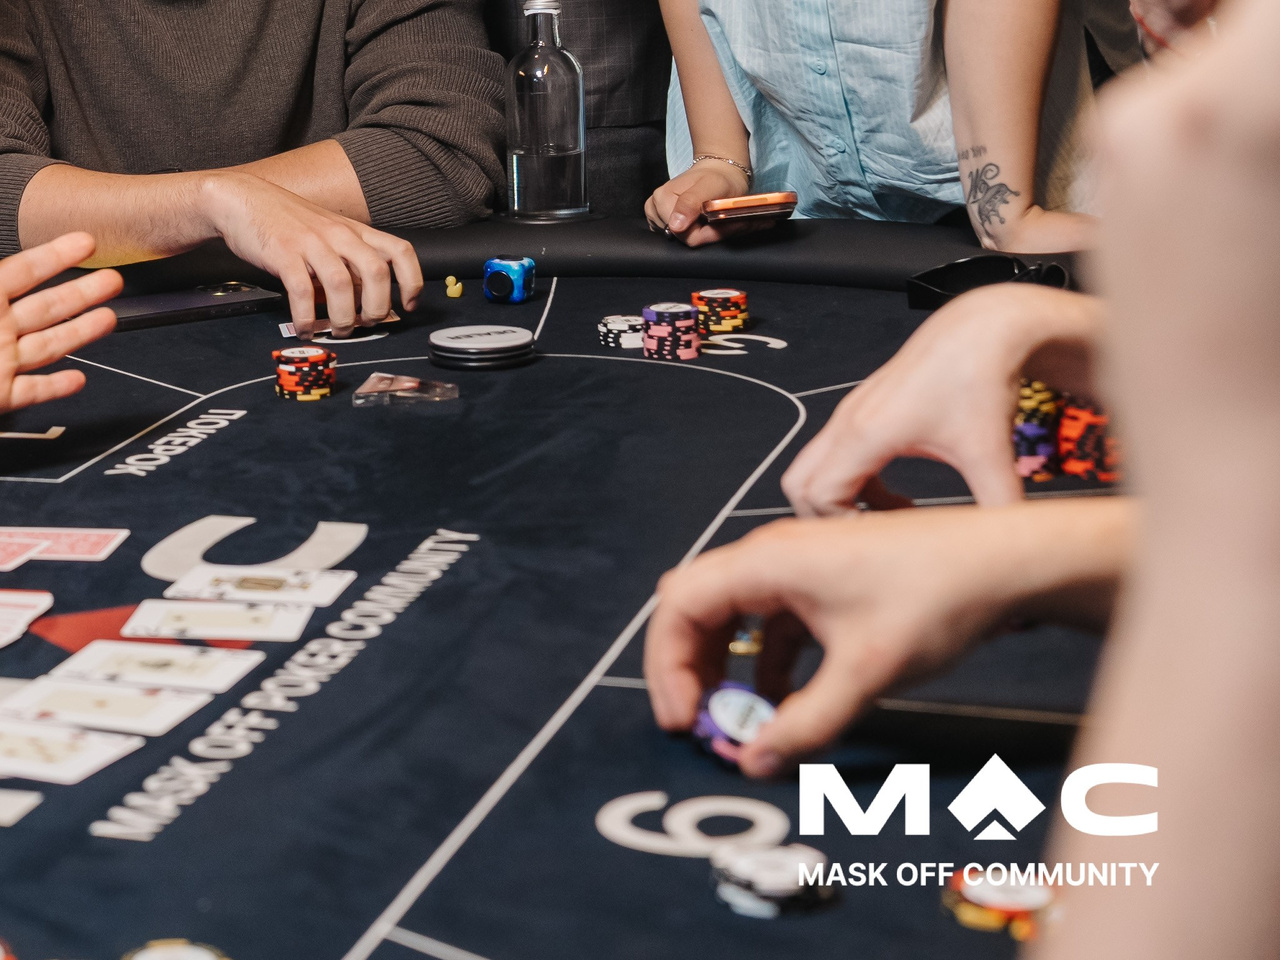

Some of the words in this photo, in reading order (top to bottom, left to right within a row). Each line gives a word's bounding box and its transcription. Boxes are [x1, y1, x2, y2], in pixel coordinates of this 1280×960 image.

[89, 755, 233, 842] MASK
[188, 707, 280, 760] OFF
[240, 637, 367, 713] POKER
[325, 528, 481, 640] COMMUNITY
